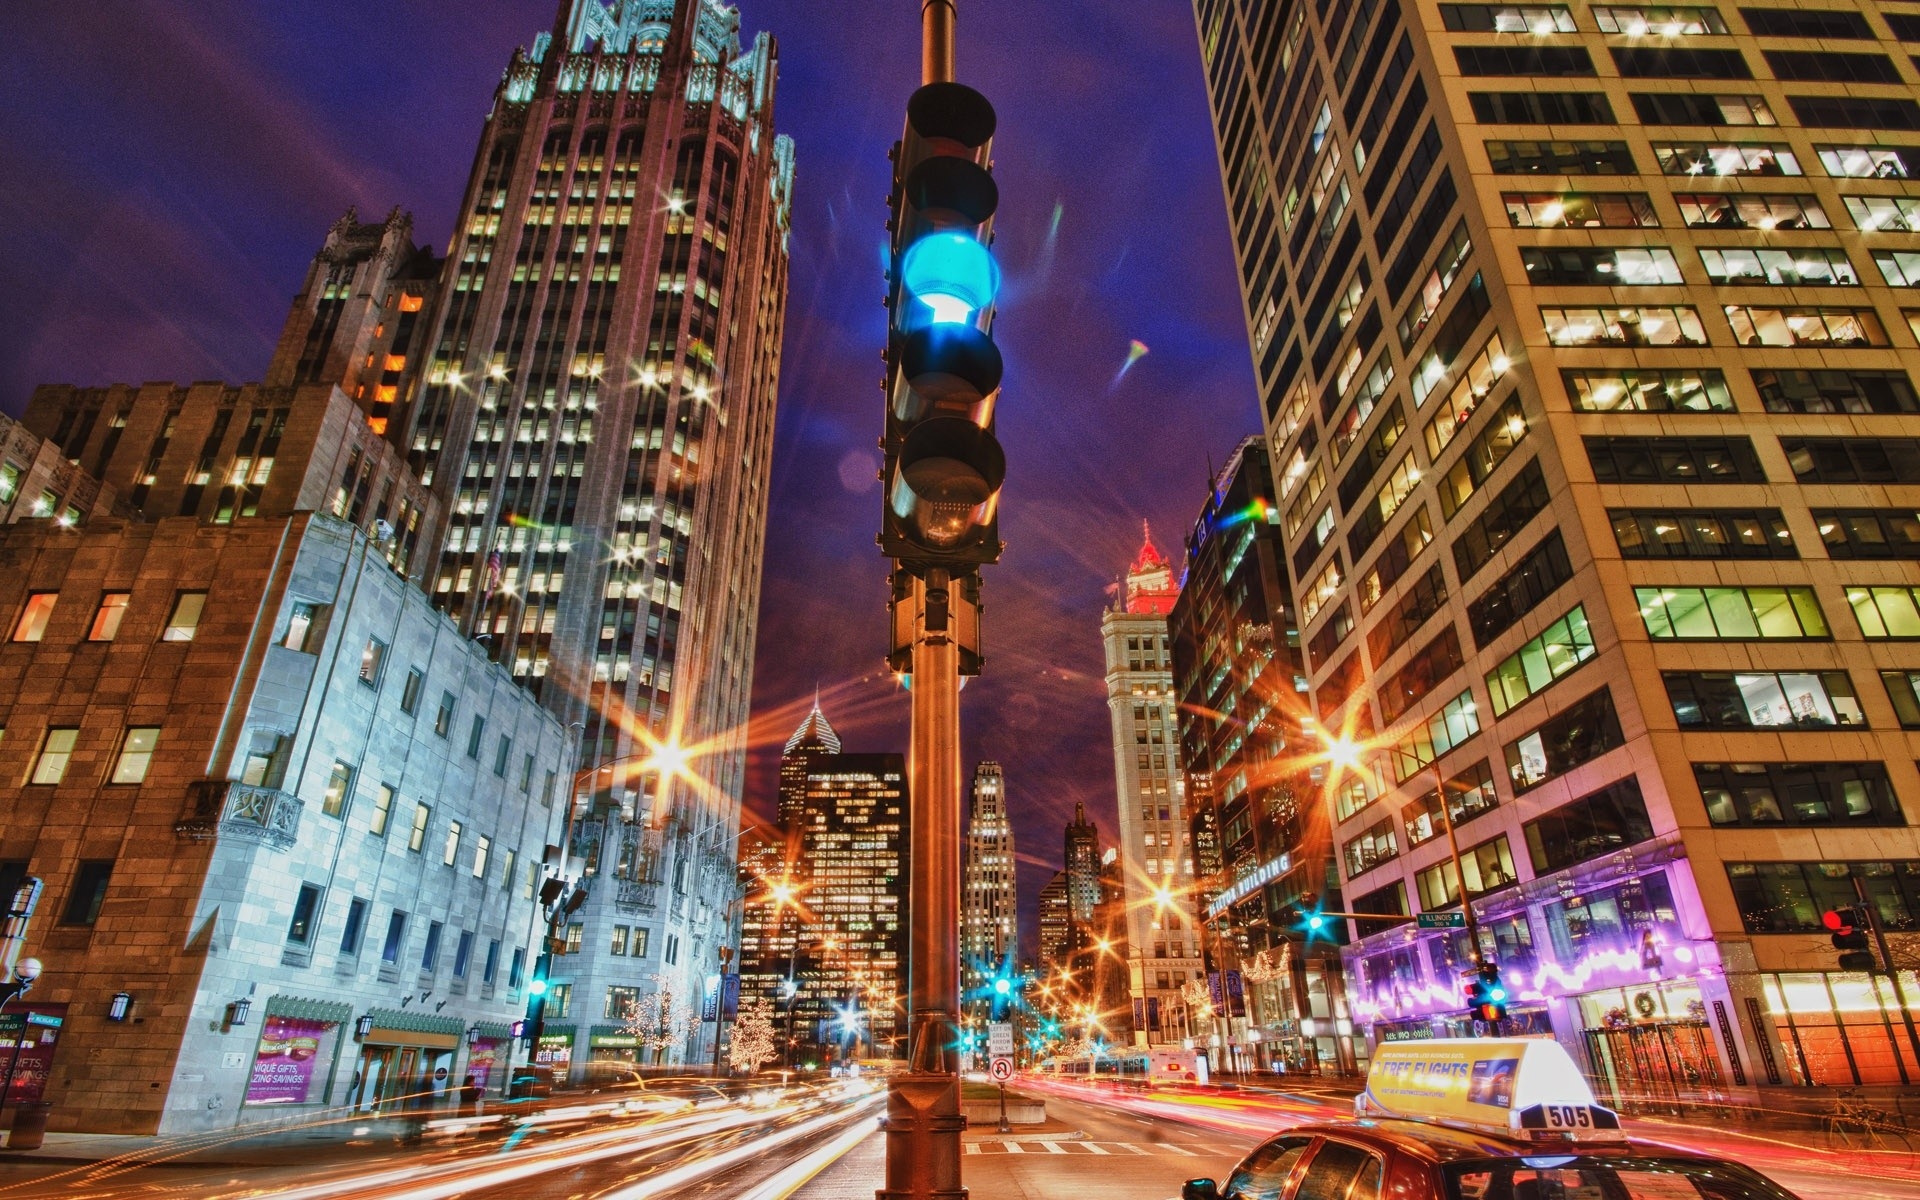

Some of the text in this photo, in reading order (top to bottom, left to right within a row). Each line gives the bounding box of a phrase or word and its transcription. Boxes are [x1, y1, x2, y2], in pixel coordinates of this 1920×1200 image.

[1238, 855, 1289, 895] BUILDING
[1425, 914, 1453, 922] ILLINOIS
[277, 1064, 298, 1074] GIFTS,
[1382, 1061, 1412, 1077] FREE
[1413, 1061, 1469, 1078] FLIGHTS
[251, 1073, 305, 1083] ZING SAVINGS!
[1497, 1094, 1509, 1103] VISA
[1547, 1105, 1590, 1128] 505
